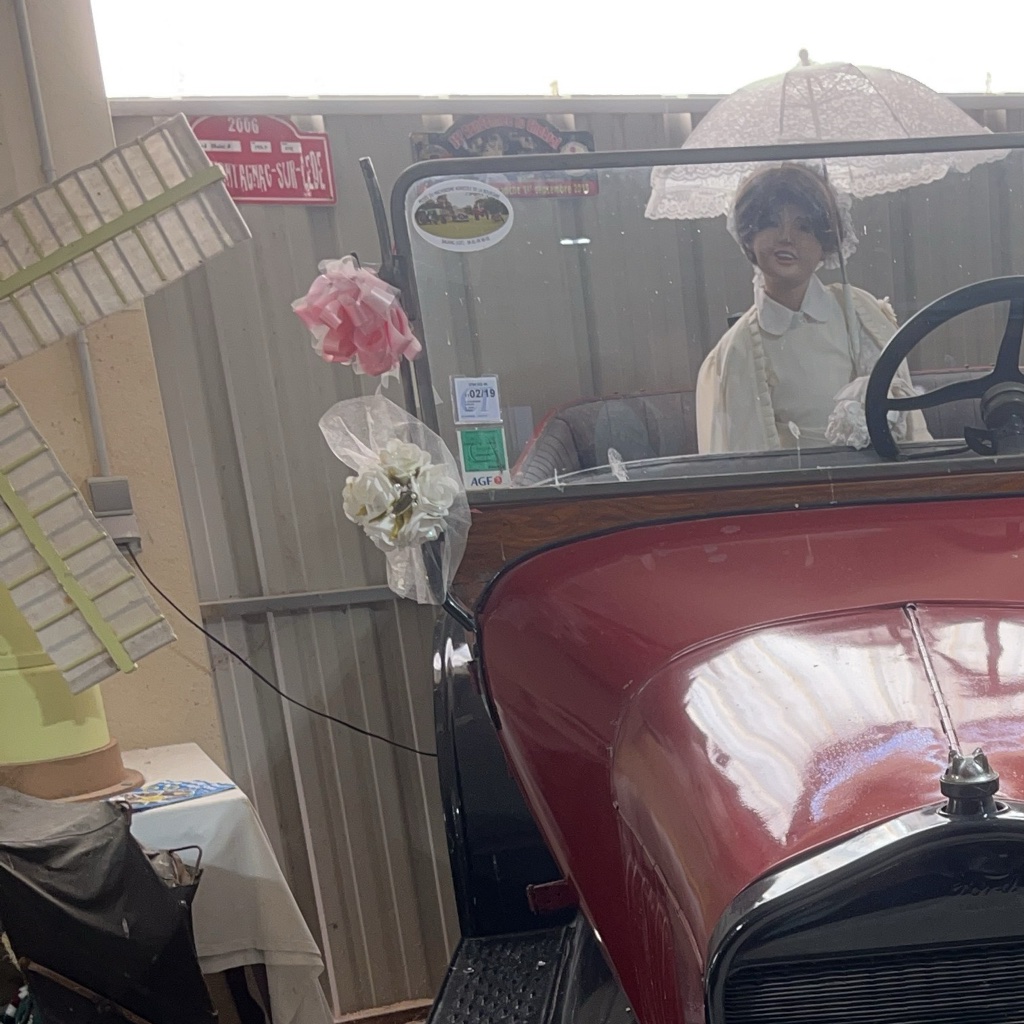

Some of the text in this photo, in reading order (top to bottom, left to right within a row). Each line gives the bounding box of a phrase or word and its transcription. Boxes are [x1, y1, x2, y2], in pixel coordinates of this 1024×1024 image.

[227, 117, 260, 134] 2006
[469, 389, 496, 399] 02/19
[470, 476, 493, 487] AGF
